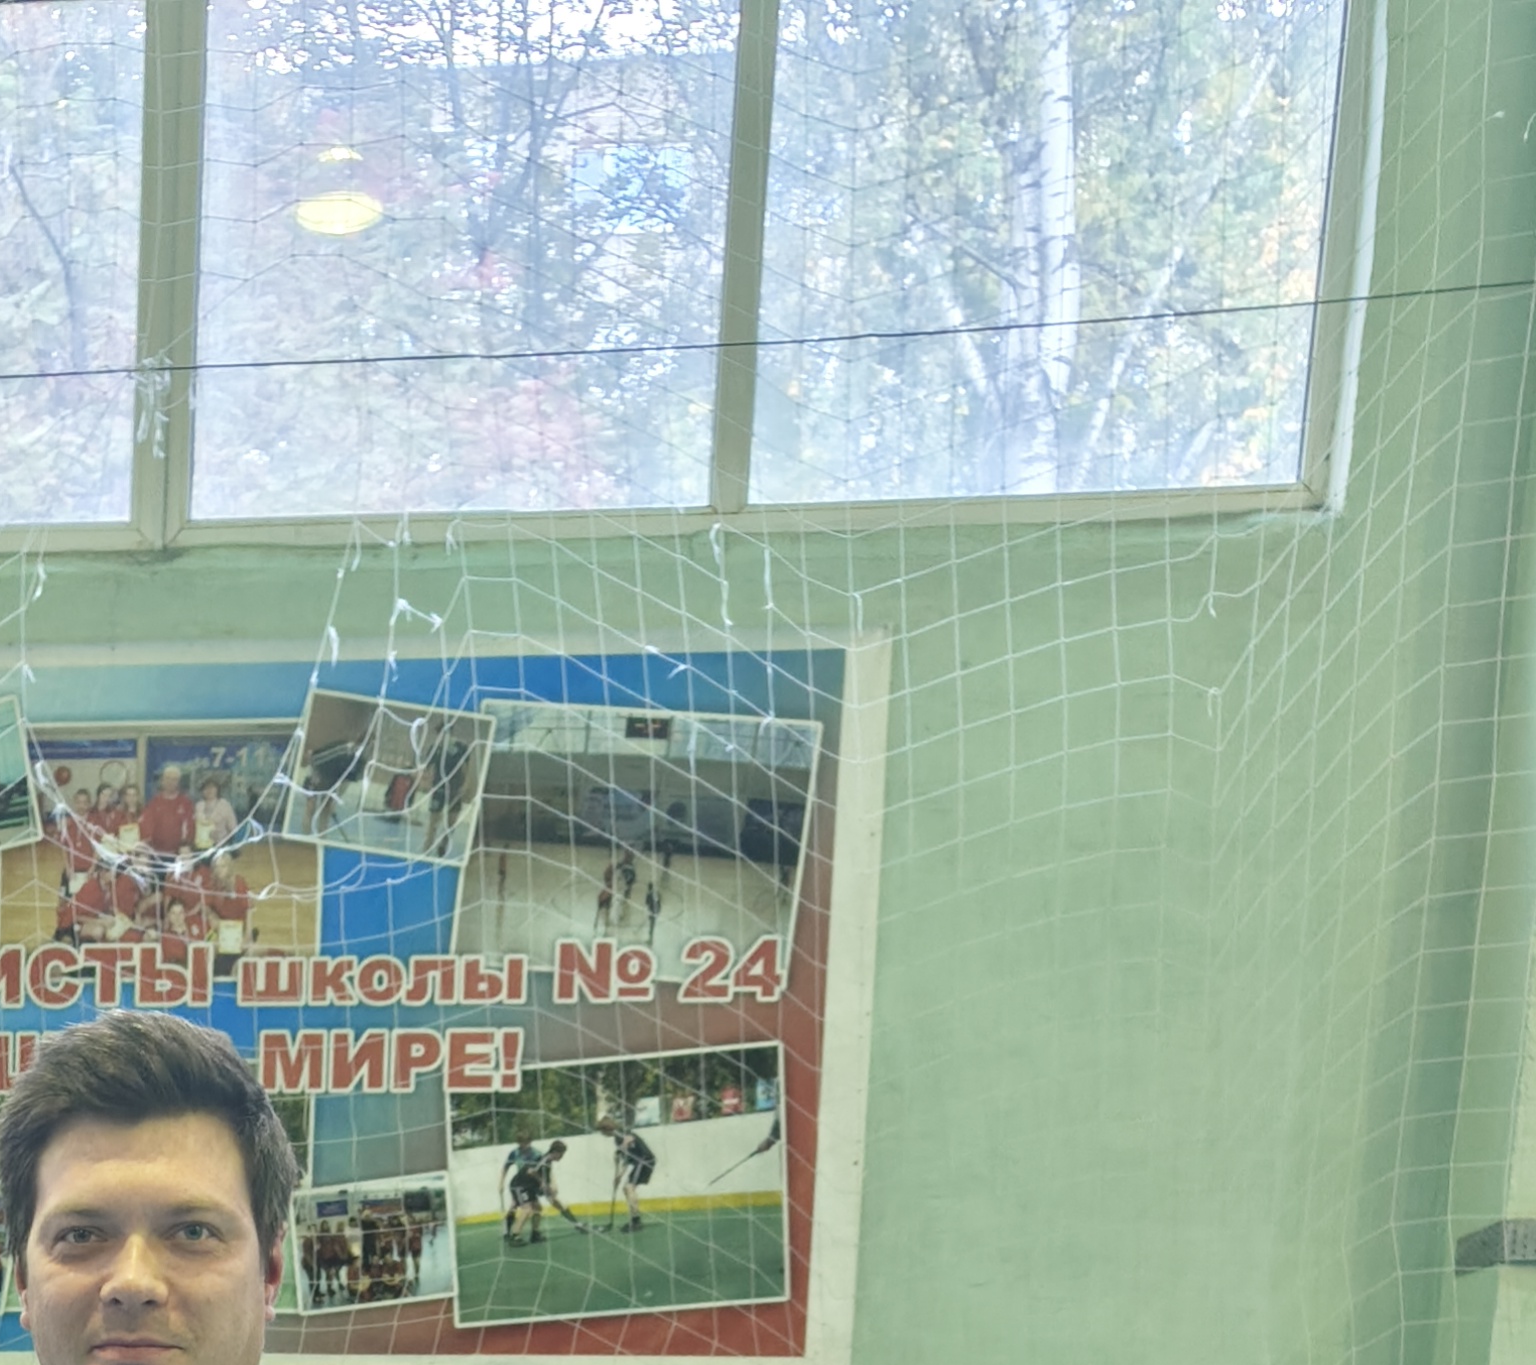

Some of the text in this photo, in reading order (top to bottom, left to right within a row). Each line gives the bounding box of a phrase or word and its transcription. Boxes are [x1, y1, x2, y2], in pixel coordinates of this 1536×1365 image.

[239, 955, 525, 1005] школы
[555, 939, 656, 1003] №
[679, 936, 783, 1003] 24
[259, 1028, 524, 1093] МИРЕ!
